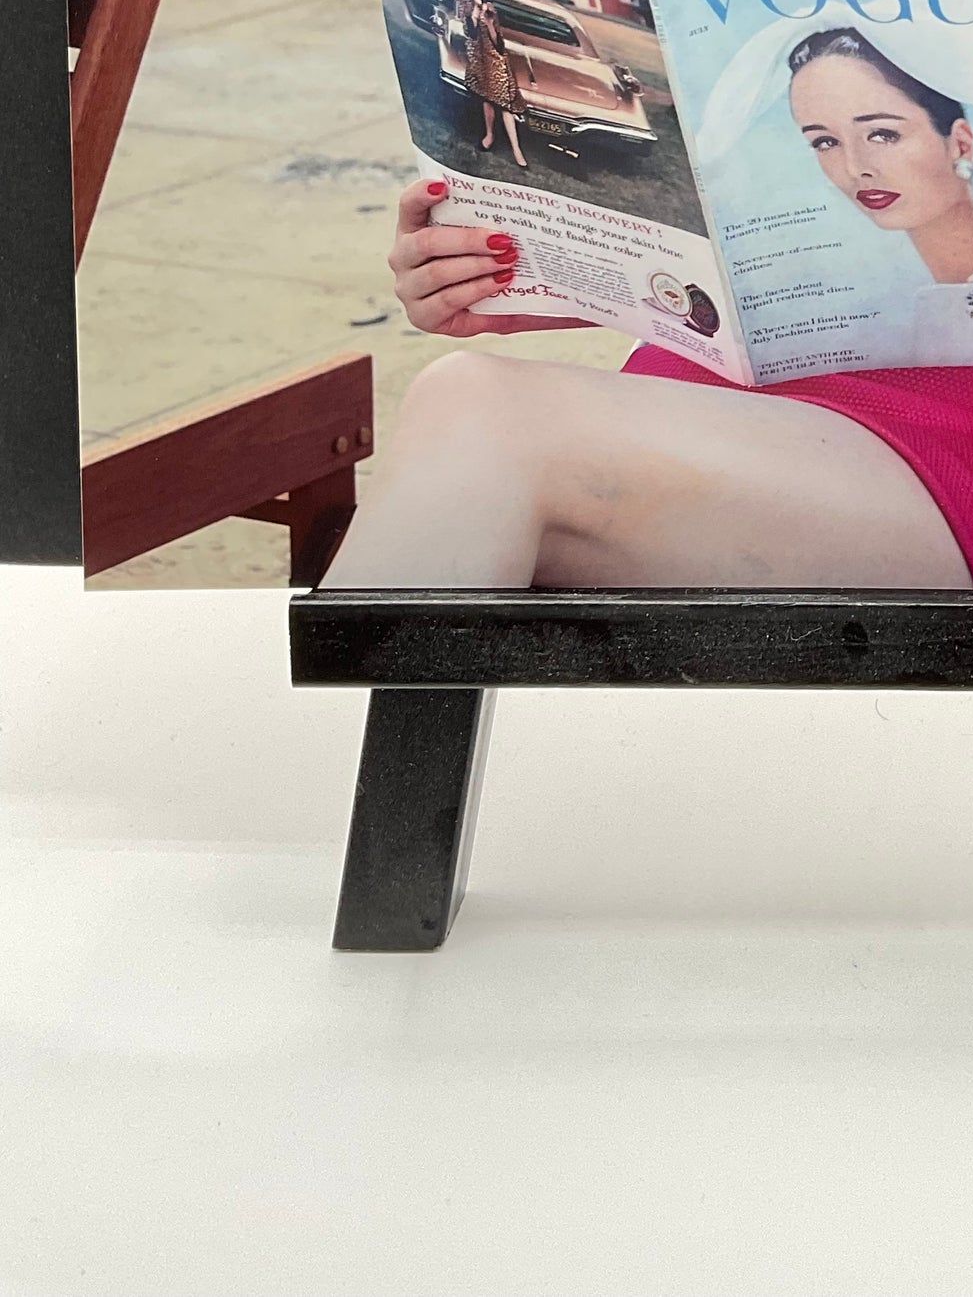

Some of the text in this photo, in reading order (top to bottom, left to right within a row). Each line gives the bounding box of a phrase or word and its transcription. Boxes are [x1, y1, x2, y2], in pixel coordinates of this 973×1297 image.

[688, 25, 709, 37] JULY
[482, 185, 560, 209] COSMETIC
[566, 204, 653, 234] DISCOVERY
[453, 196, 476, 205] you
[480, 200, 503, 209] can
[506, 204, 552, 222] actually
[556, 216, 597, 235] change
[600, 228, 628, 242] your
[631, 237, 655, 250] skin
[722, 224, 744, 233] The
[747, 217, 761, 225] 20
[725, 215, 816, 241] beauty questions
[474, 210, 643, 259] to go with any fashion color
[733, 262, 773, 276] clothes
[538, 283, 570, 300] Face
[740, 281, 822, 303] The facts about
[741, 286, 855, 311] liquid reducing diets
[790, 321, 809, 329] can
[817, 314, 838, 324] find
[750, 322, 850, 345] July fashion needs
